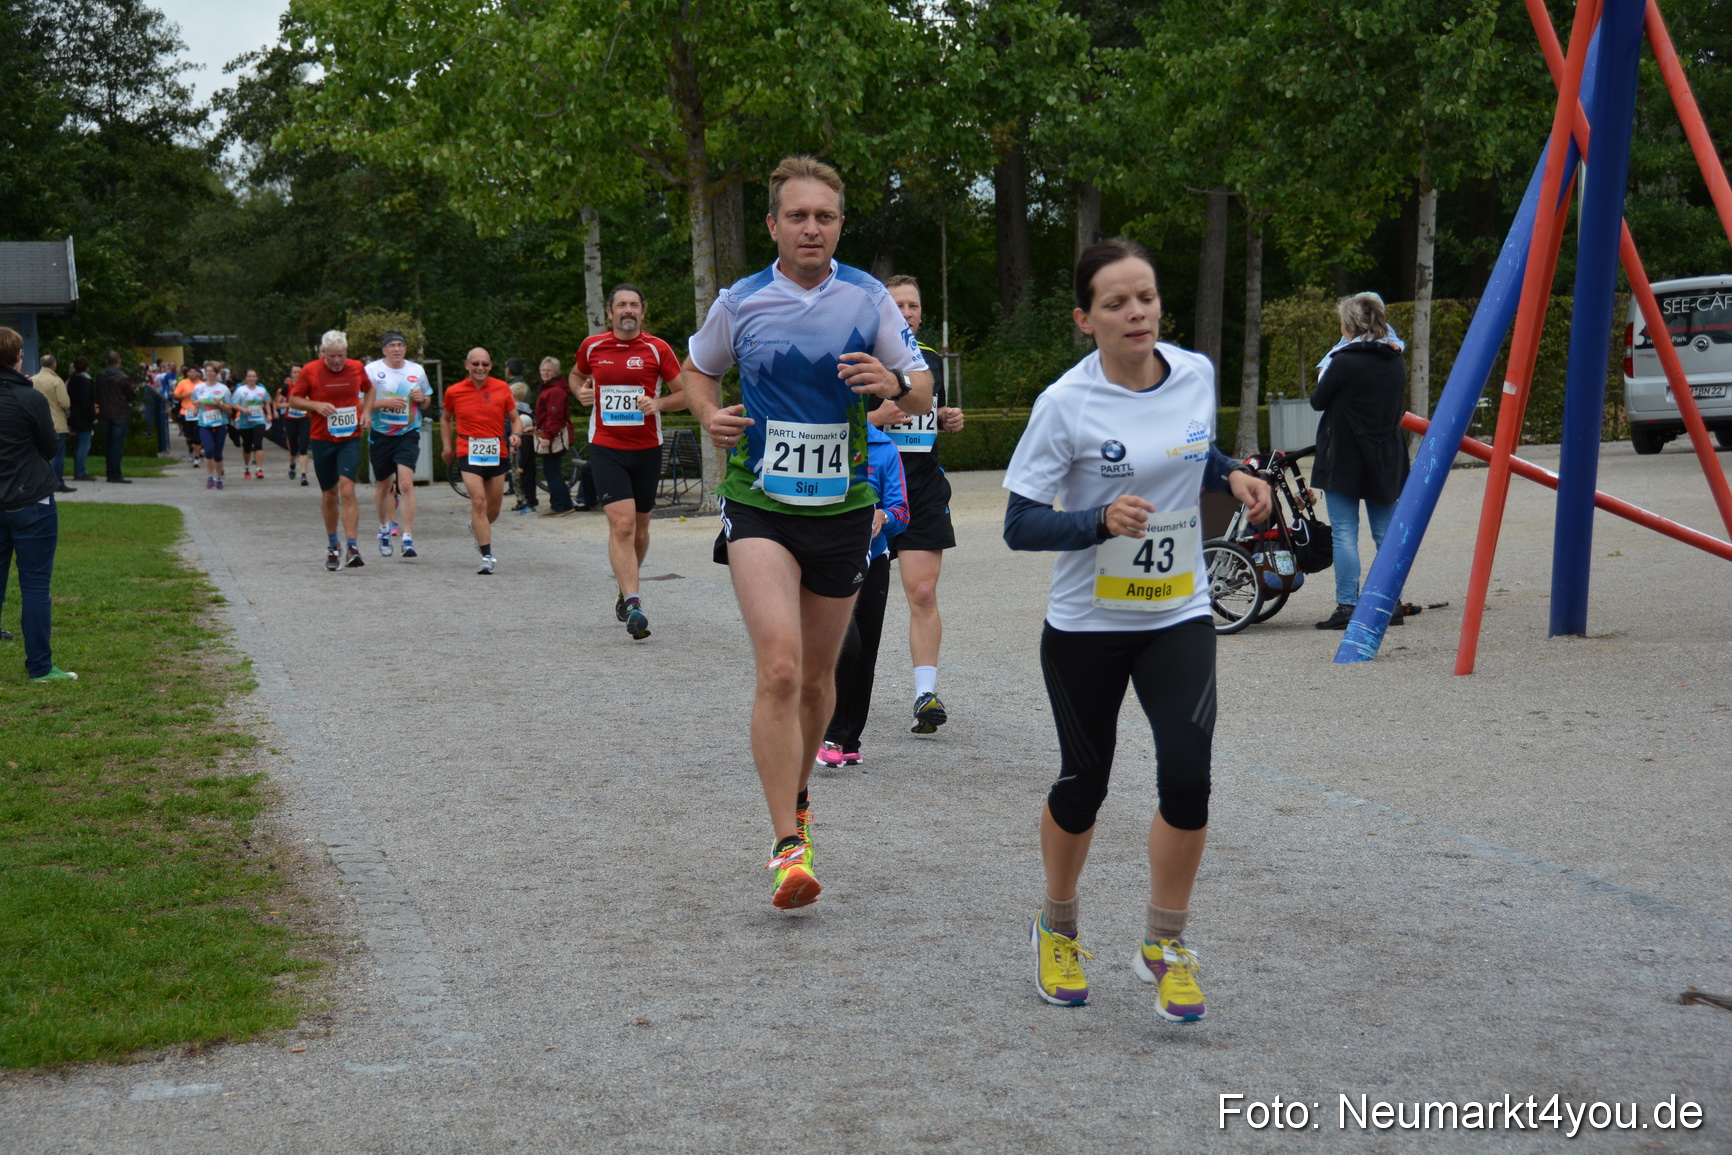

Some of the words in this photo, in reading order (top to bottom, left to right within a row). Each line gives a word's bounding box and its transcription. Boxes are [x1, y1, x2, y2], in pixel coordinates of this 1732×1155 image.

[1711, 387, 1723, 395] 22
[605, 395, 639, 410] 2781
[331, 413, 356, 427] 2600
[768, 428, 797, 439] PARTL
[798, 431, 838, 440] Neumarkt
[905, 435, 921, 444] Toni
[472, 443, 498, 455] 2245
[772, 441, 843, 474] 2114
[1100, 463, 1134, 473] PARTL
[1101, 471, 1135, 479] Neumarkt
[795, 481, 819, 497] Sigi
[1143, 520, 1187, 533] Neumarkt
[1132, 537, 1175, 573] 43
[1125, 583, 1172, 601] Angela
